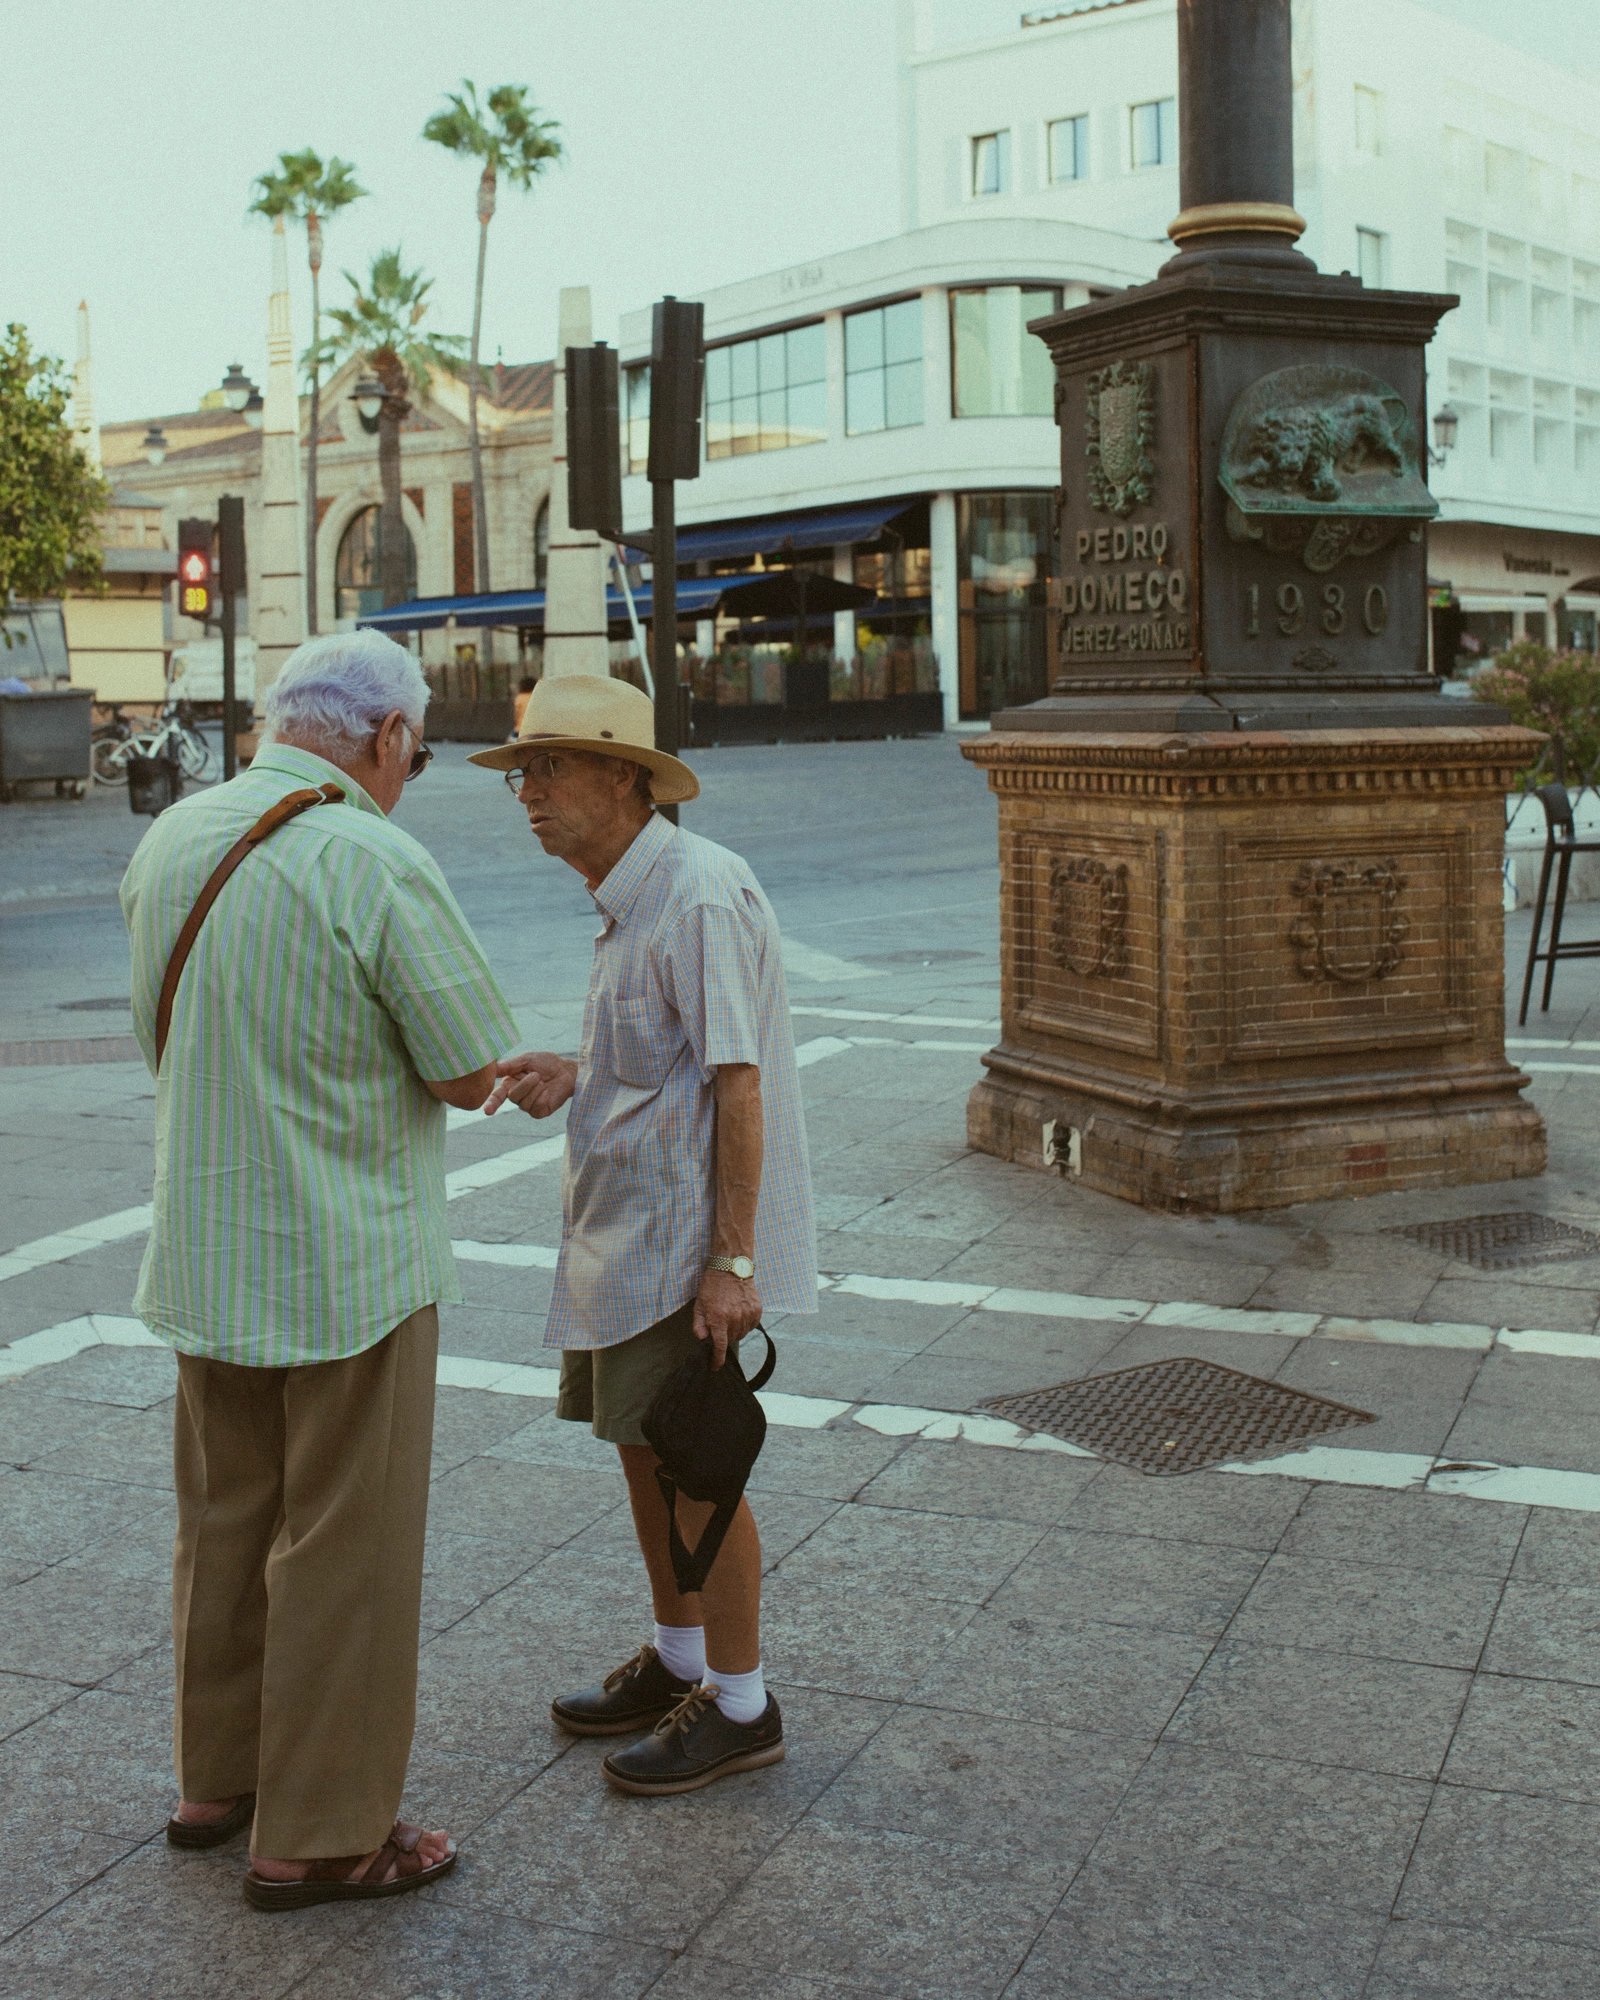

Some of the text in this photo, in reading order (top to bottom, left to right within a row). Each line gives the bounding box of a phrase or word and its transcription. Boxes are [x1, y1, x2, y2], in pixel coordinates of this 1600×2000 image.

[1077, 522, 1168, 562] PEDRO
[1061, 569, 1187, 614] DOMECQ
[1247, 583, 1388, 634] 1930
